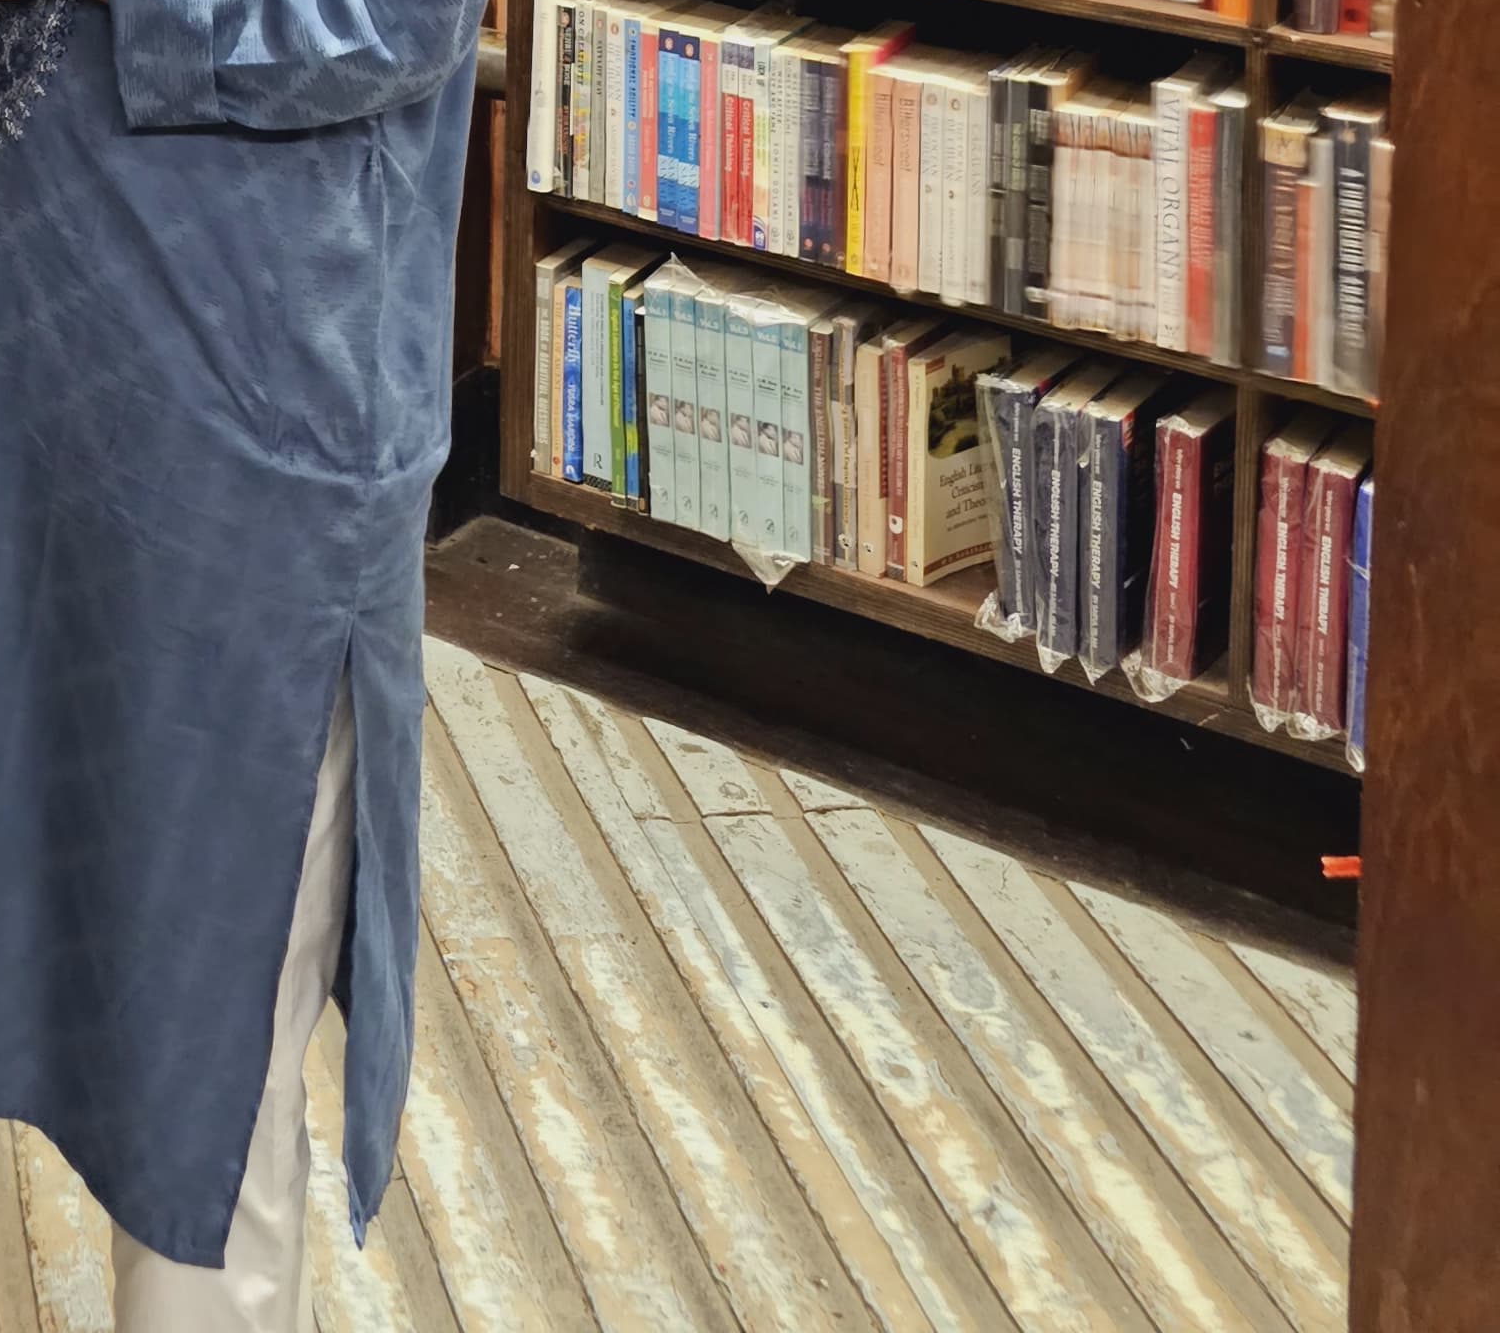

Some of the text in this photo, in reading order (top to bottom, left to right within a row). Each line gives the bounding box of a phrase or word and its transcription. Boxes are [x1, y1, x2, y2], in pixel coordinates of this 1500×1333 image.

[667, 100, 675, 124] Seven
[724, 96, 734, 172] Critical Thinking
[667, 126, 675, 154] Rivers
[688, 133, 696, 161] Rivers
[740, 100, 751, 177] Critical Thinking
[1163, 98, 1180, 280] VITAL ORGANS
[1340, 168, 1364, 178] A
[539, 320, 549, 342] BOOK
[566, 304, 581, 366] Butterfly
[539, 351, 549, 395] BEAUTIFUL
[539, 398, 549, 444] QUESTIONS
[939, 465, 968, 488] English
[946, 503, 962, 519] and
[1011, 447, 1023, 555] ENGLISH THERAPY
[1090, 480, 1102, 589] ENGLISH THERAPY
[1169, 492, 1182, 588] ENGLISH THERAPY
[1318, 535, 1332, 635] ENGLISH THERAPY
